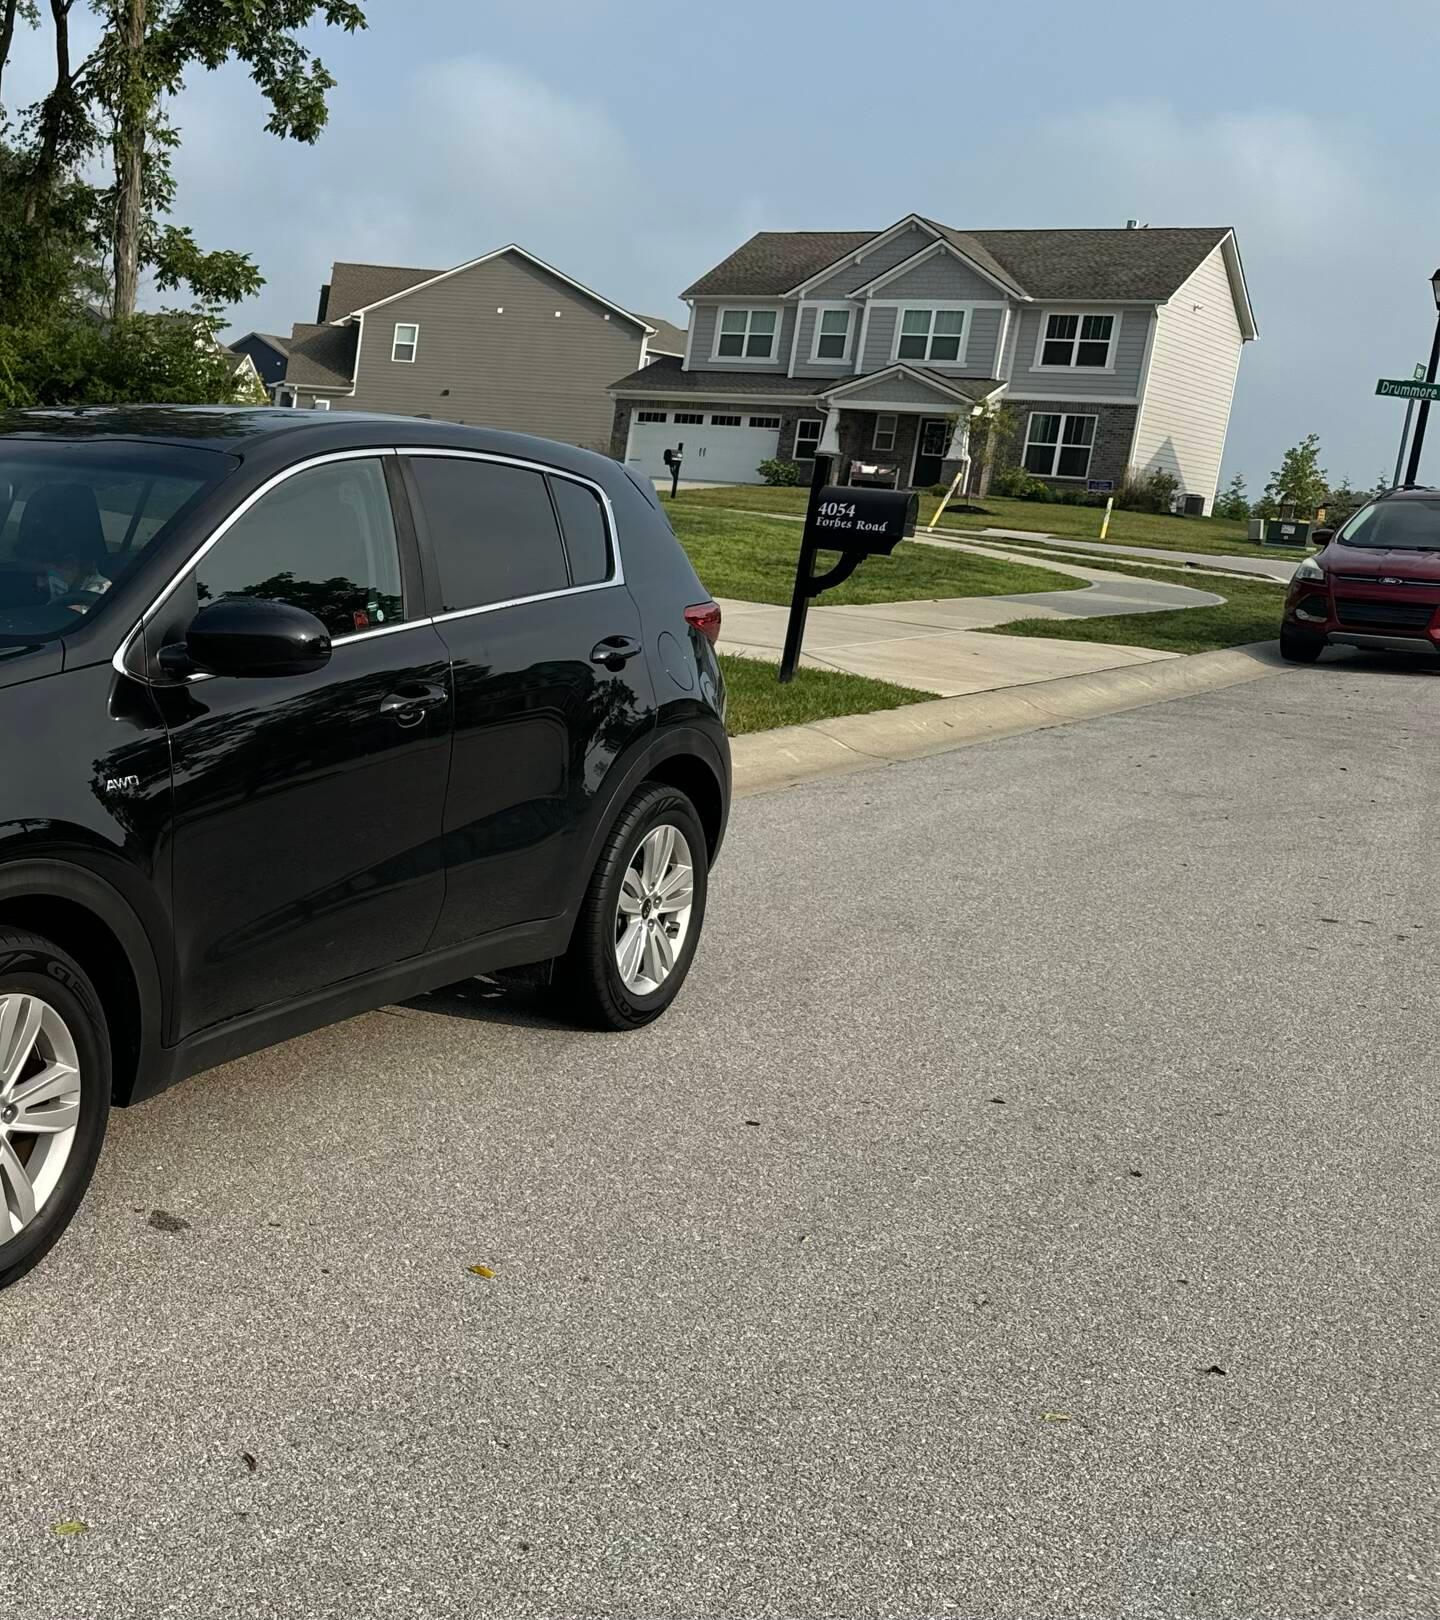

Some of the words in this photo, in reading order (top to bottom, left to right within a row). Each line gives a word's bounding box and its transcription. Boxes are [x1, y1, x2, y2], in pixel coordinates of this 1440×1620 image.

[1380, 381, 1438, 398] Drummore
[817, 502, 856, 517] 4054
[816, 516, 852, 529] Forbes
[856, 520, 889, 532] Road
